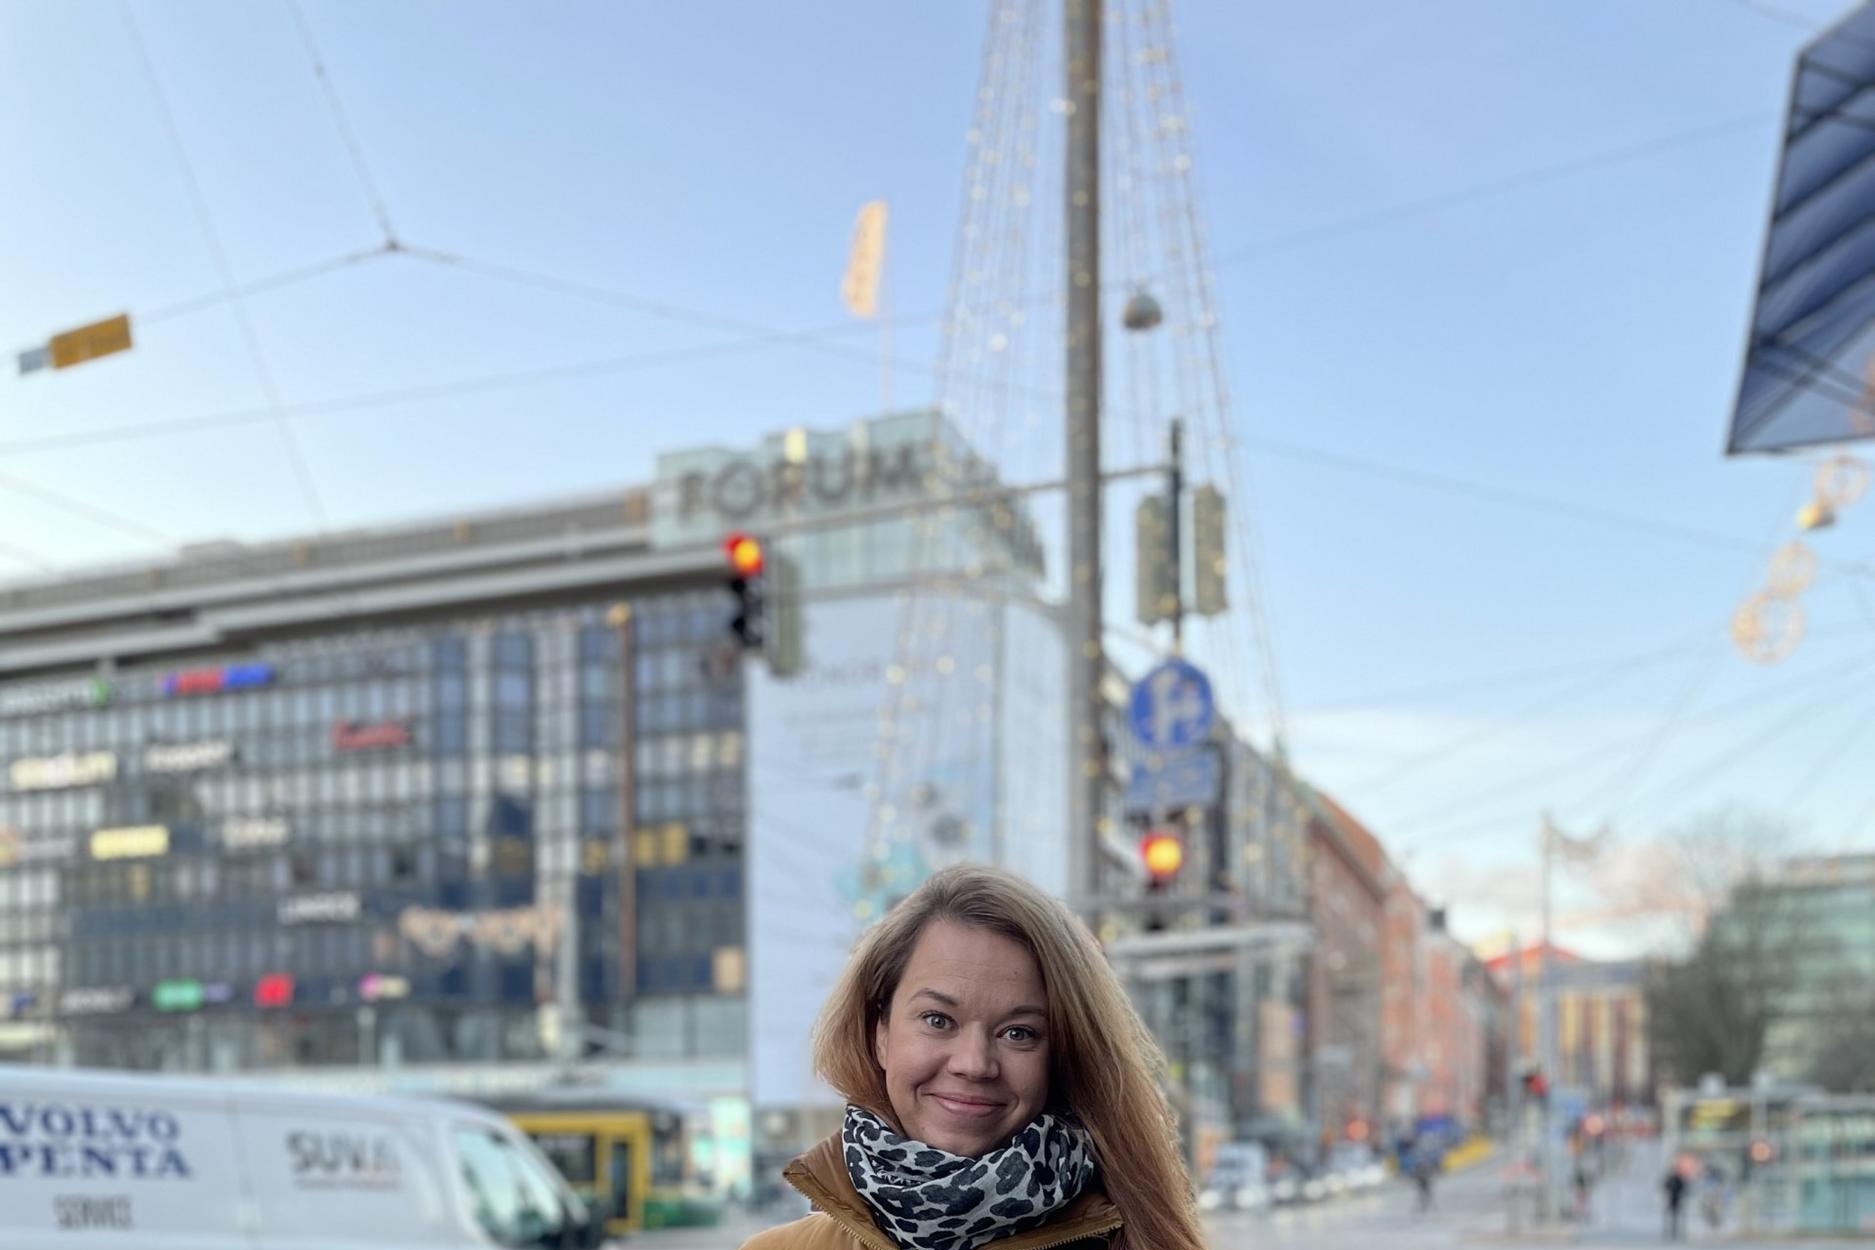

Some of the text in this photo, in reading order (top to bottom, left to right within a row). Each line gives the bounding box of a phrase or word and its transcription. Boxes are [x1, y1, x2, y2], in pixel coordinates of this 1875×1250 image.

[678, 443, 922, 523] FORUM
[0, 1104, 180, 1143] VOLVO
[0, 1144, 191, 1178] PENTA
